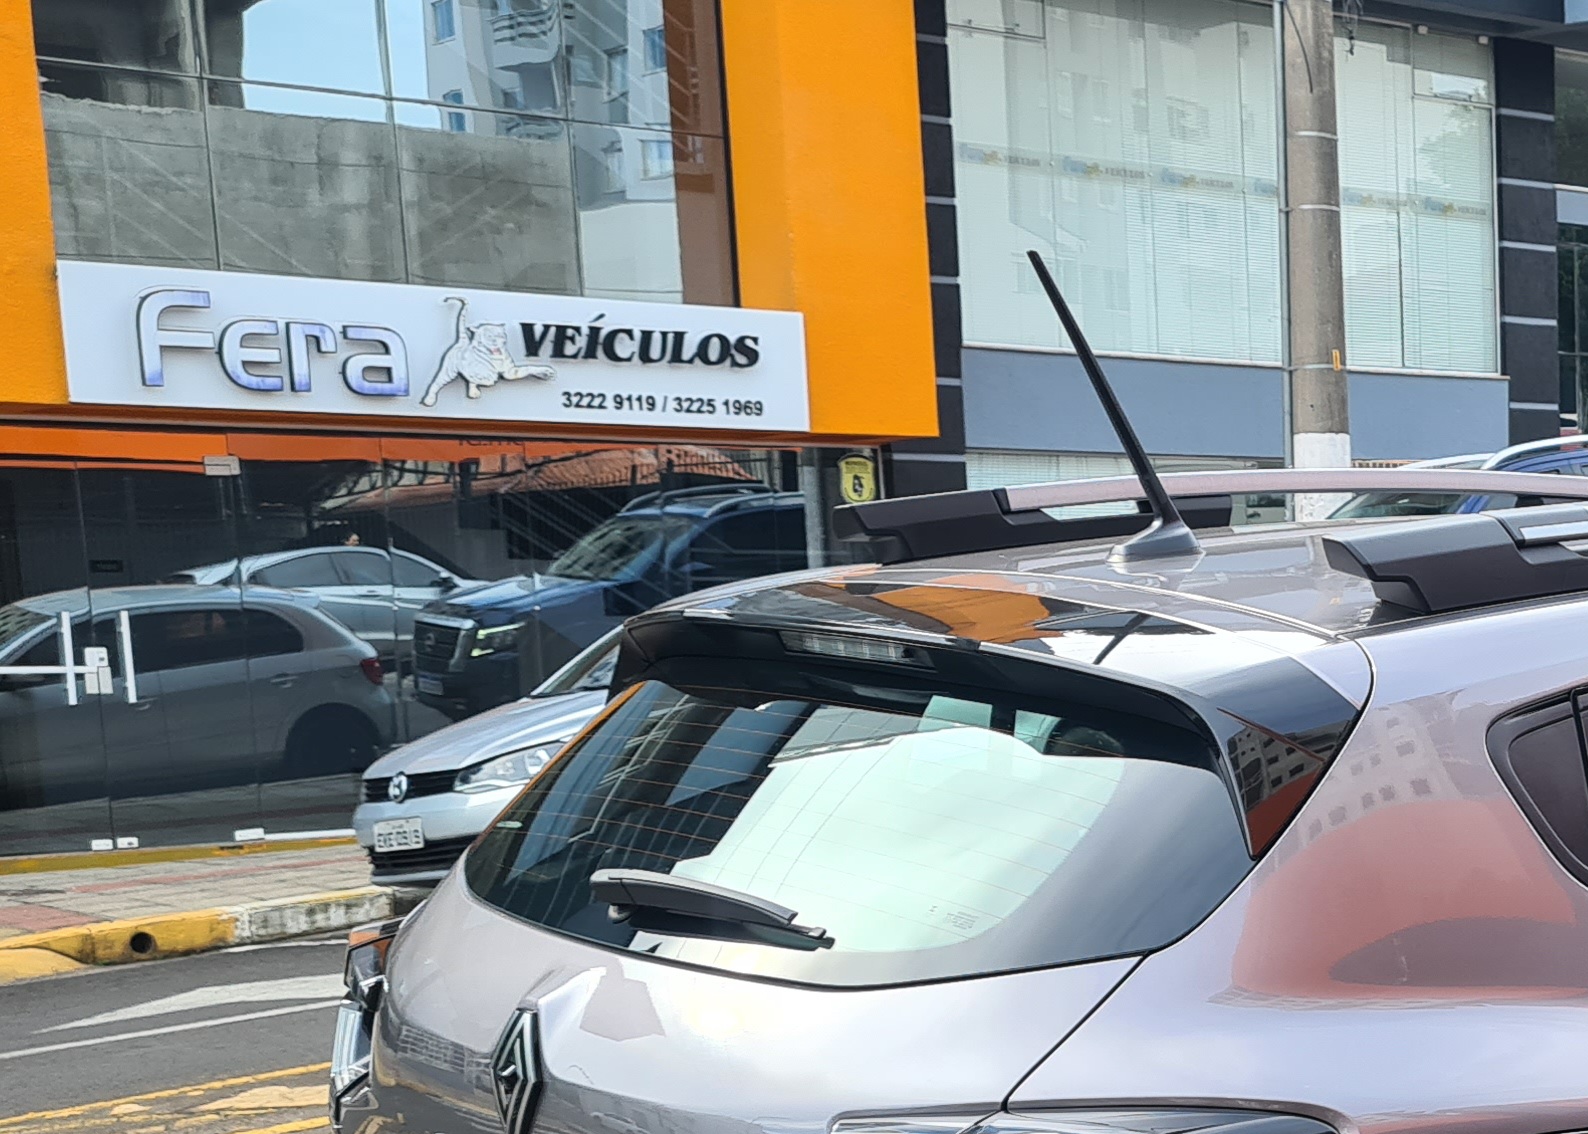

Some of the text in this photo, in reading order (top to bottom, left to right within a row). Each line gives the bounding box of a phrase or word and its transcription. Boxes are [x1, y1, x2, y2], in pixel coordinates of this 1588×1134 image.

[135, 285, 760, 397] Fera VEÍCULOS
[561, 391, 608, 410] 3222
[613, 394, 657, 413] 9119
[672, 396, 717, 415] 3225
[723, 399, 764, 417] 1969
